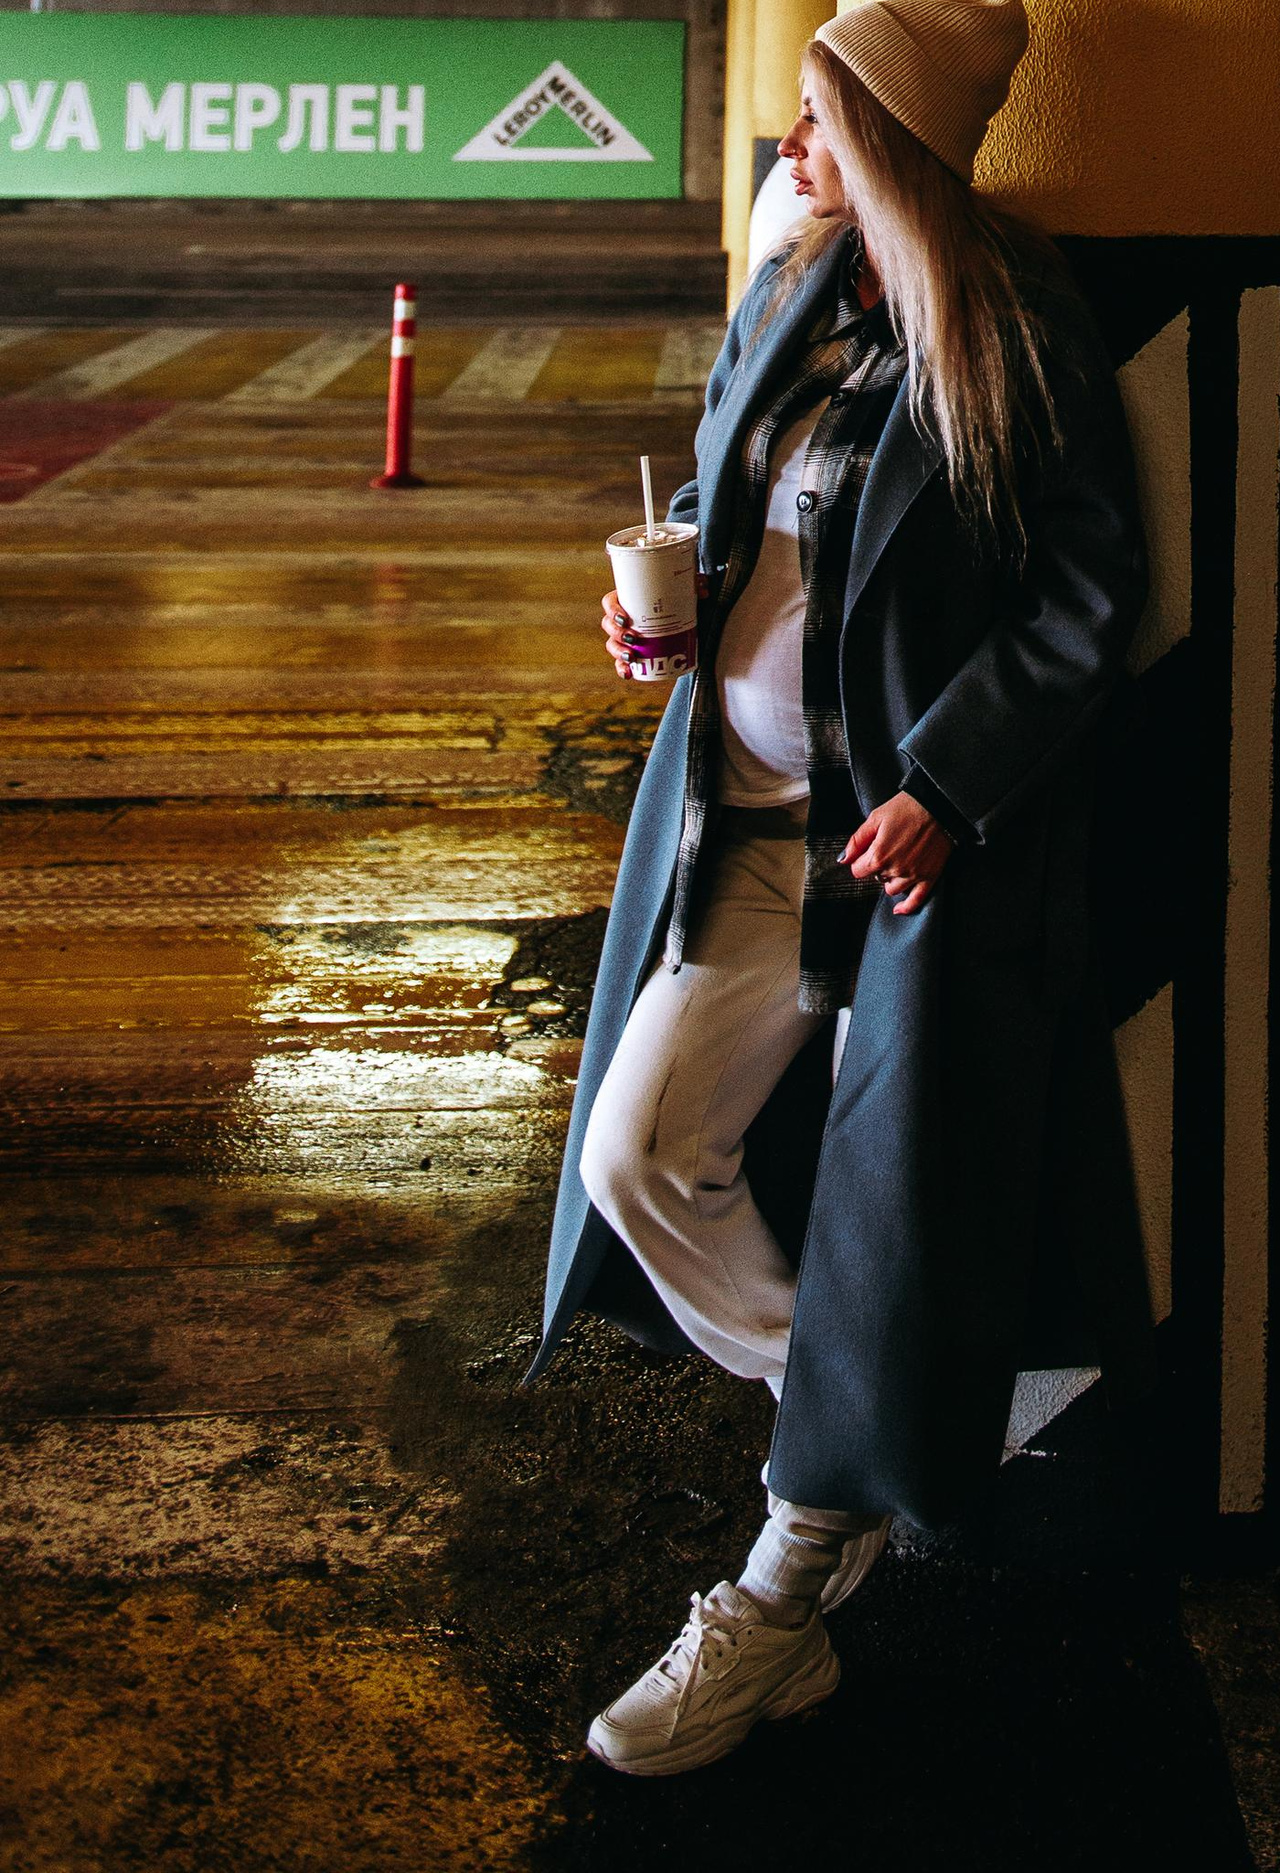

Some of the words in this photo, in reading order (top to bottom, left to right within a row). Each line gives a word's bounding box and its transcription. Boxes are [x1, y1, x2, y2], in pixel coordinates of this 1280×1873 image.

[0, 79, 101, 151] УА
[126, 82, 426, 153] МЕРЛЕН
[494, 89, 550, 146] LEROY
[548, 76, 616, 146] MERLIN
